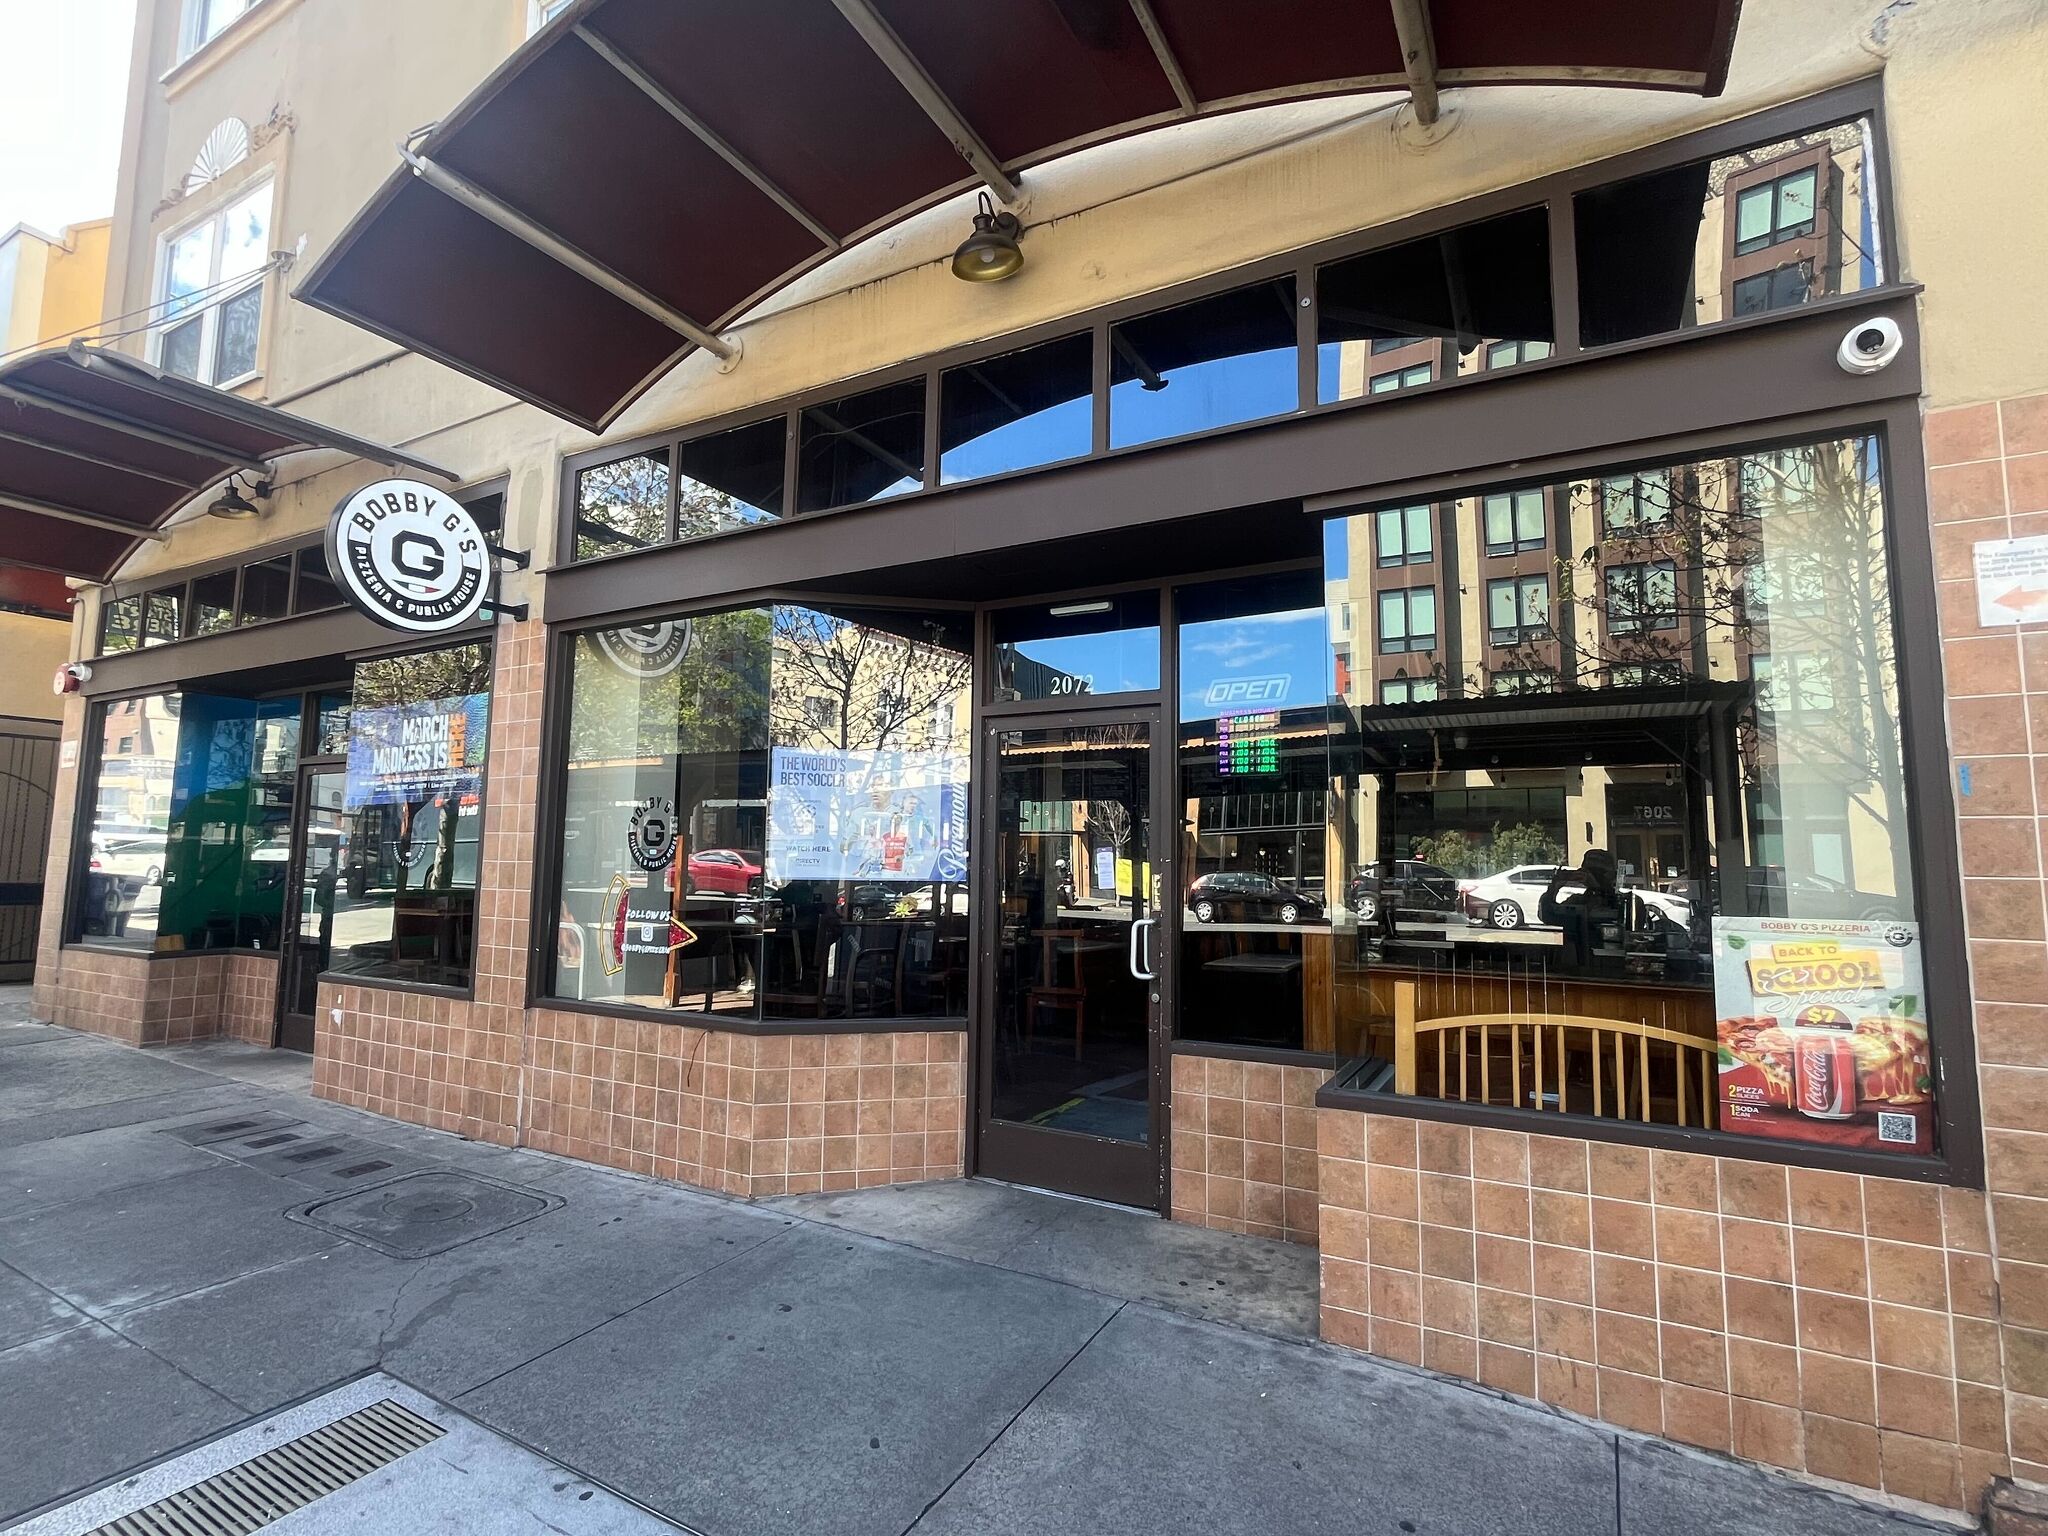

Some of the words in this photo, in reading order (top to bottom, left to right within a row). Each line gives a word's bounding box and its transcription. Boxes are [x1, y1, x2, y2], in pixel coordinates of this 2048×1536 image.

[351, 492, 437, 533] BOBBY
[443, 513, 478, 553] G'S
[391, 530, 445, 581] G
[354, 546, 393, 603] PIZZERIA
[407, 601, 453, 616] PUBLIC
[452, 571, 476, 606] HOUSE
[1050, 674, 1094, 696] 2072
[1209, 678, 1286, 703] OPEN
[402, 714, 450, 744] MARCH
[372, 743, 432, 775] MADNESS
[433, 741, 448, 769] IS
[781, 756, 800, 770] THE
[801, 757, 846, 772] WORLD'S
[780, 772, 806, 787] BEST
[643, 819, 665, 847] G
[811, 845, 831, 853] HERE
[625, 908, 660, 921] FOLLOW
[659, 910, 671, 921] US
[1760, 922, 1798, 930] BOBBY
[1821, 924, 1871, 932] PIZZERIA
[1778, 947, 1814, 958] BACK
[1820, 946, 1838, 955] TO
[1756, 961, 1881, 990] SCHOOL
[1759, 969, 1865, 1019] Special
[1807, 1006, 1836, 1024] $7
[1728, 1084, 1737, 1098] 2
[1736, 1086, 1765, 1095] PIZZA
[1730, 1104, 1736, 1116] 1
[1735, 1105, 1759, 1113] SODA
